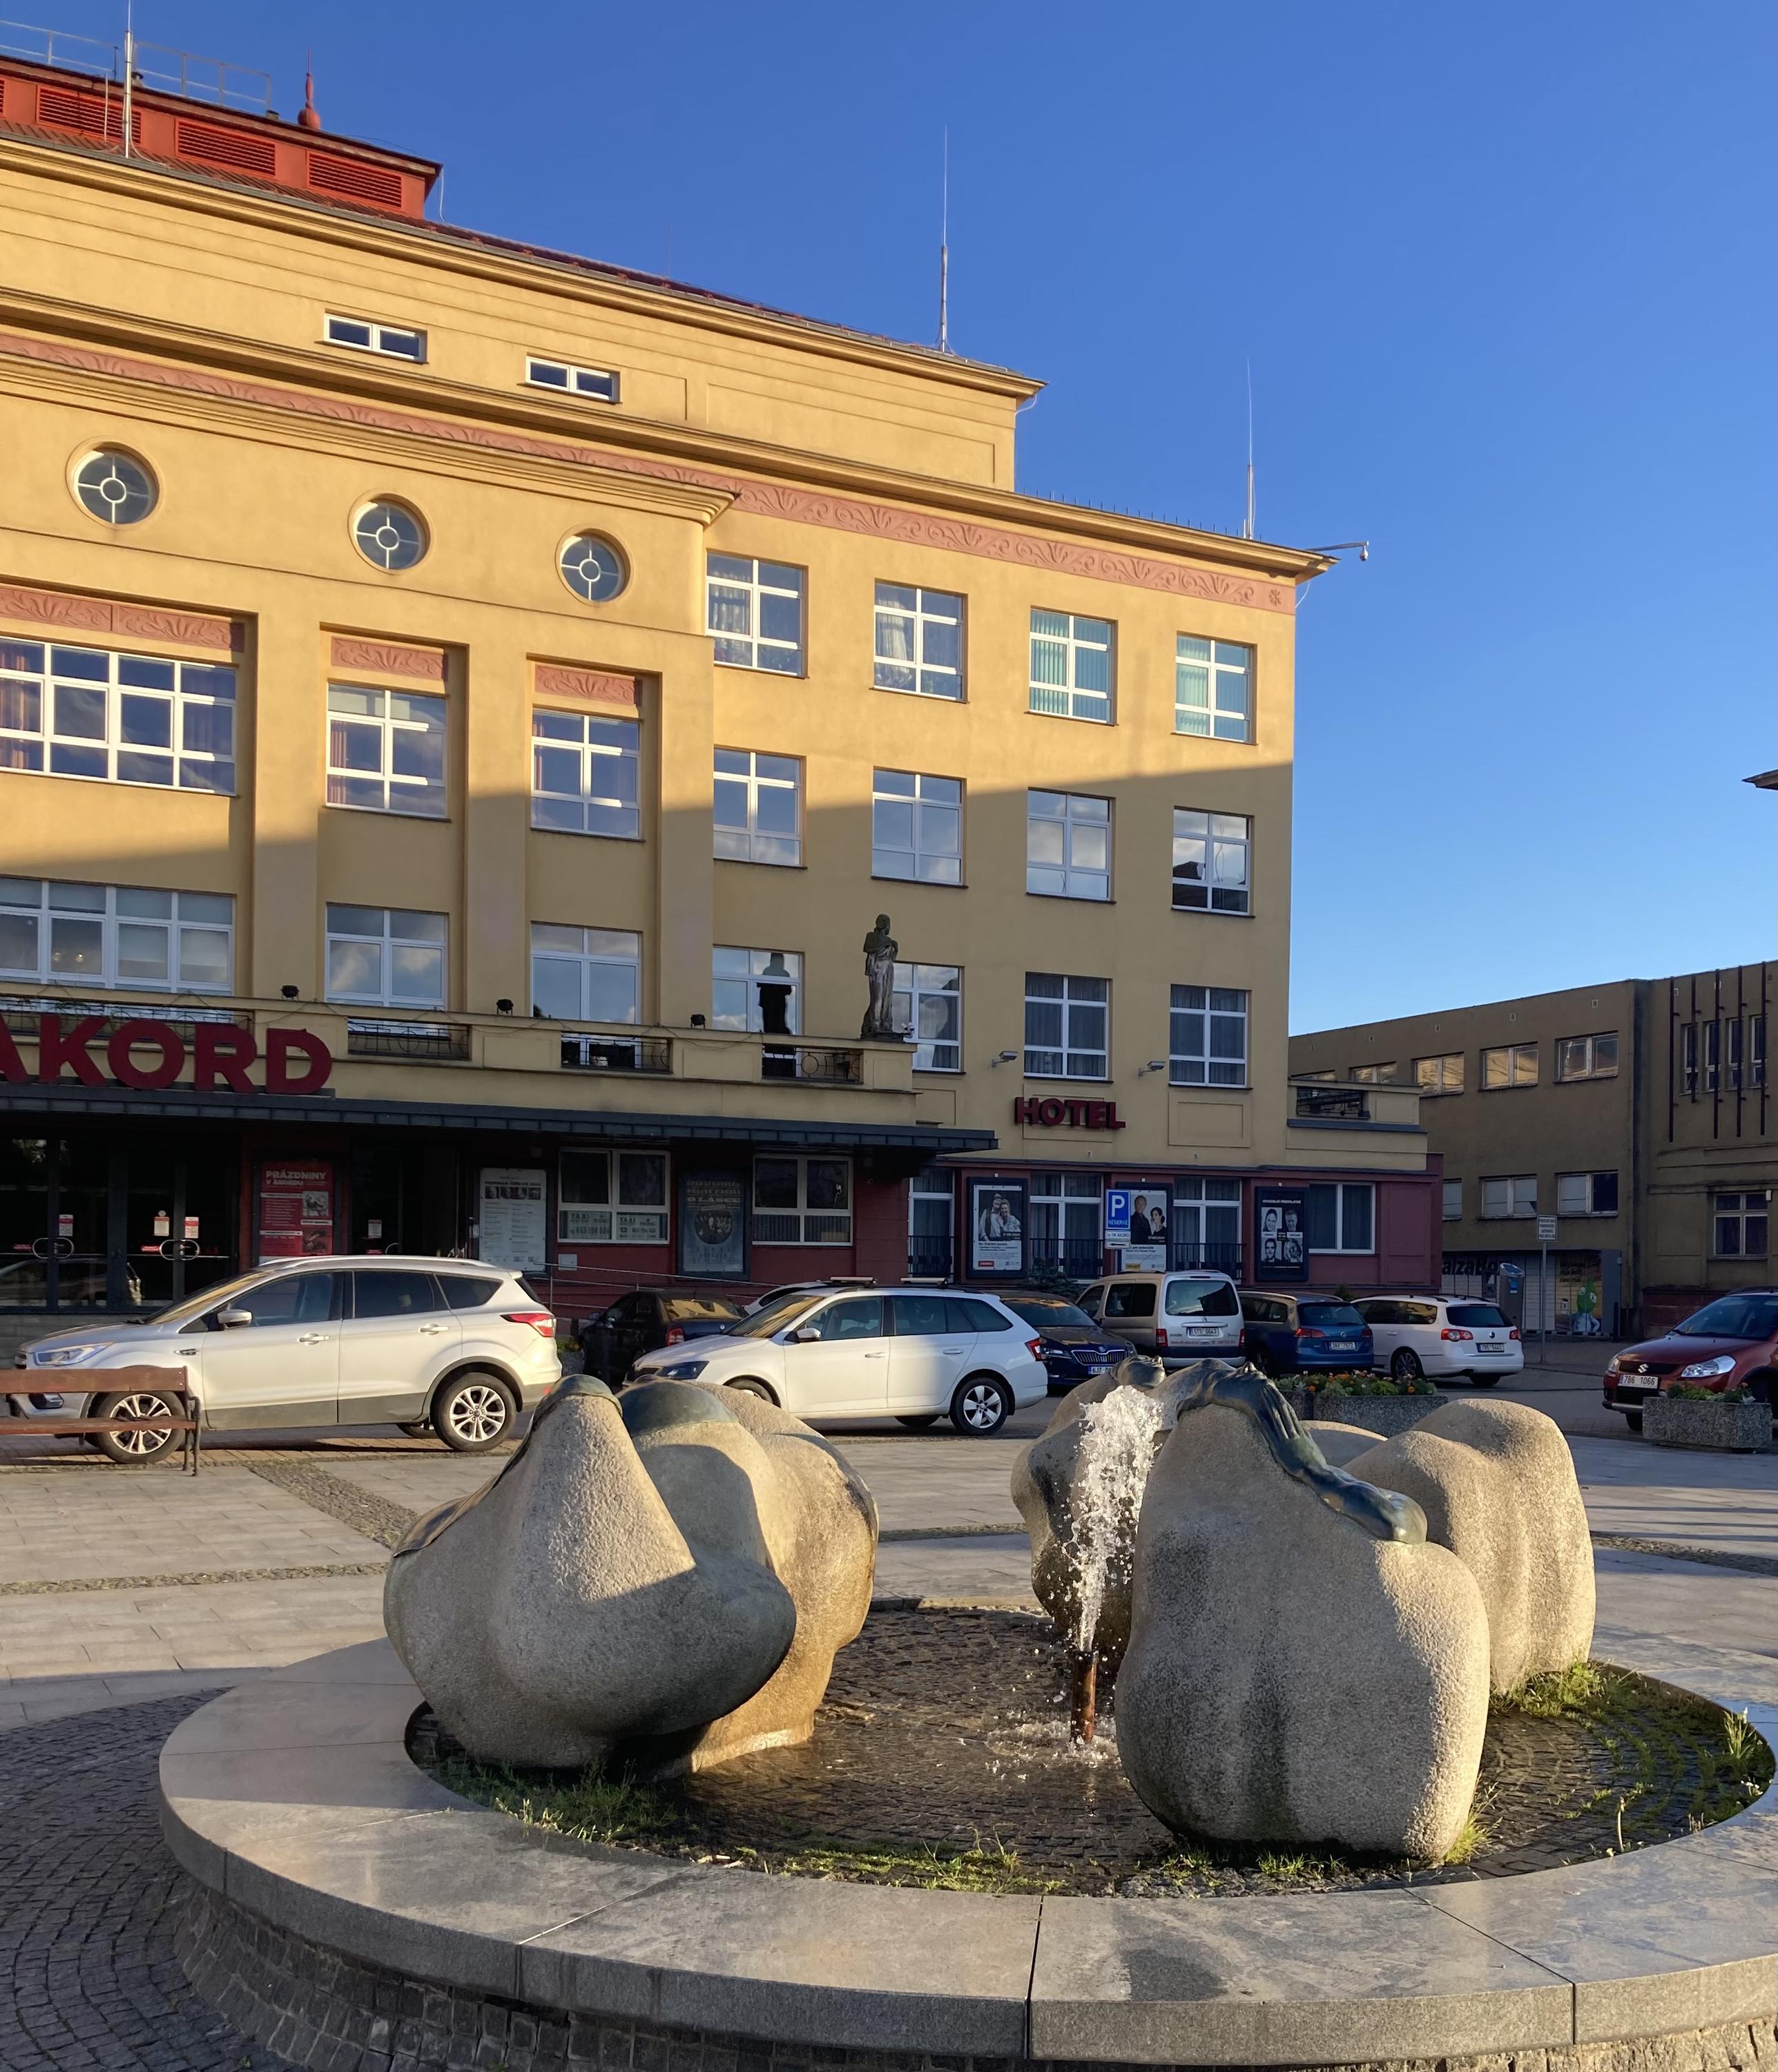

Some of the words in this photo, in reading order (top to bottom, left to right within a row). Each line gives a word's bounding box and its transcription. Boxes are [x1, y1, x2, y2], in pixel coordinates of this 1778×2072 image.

[1014, 1097, 1126, 1129] HOTEL
[265, 1170, 326, 1180] PRÁZDNINY
[1111, 1195, 1125, 1218] P
[1623, 1375, 1636, 1384] 7B6
[1640, 1376, 1656, 1385] 1066
